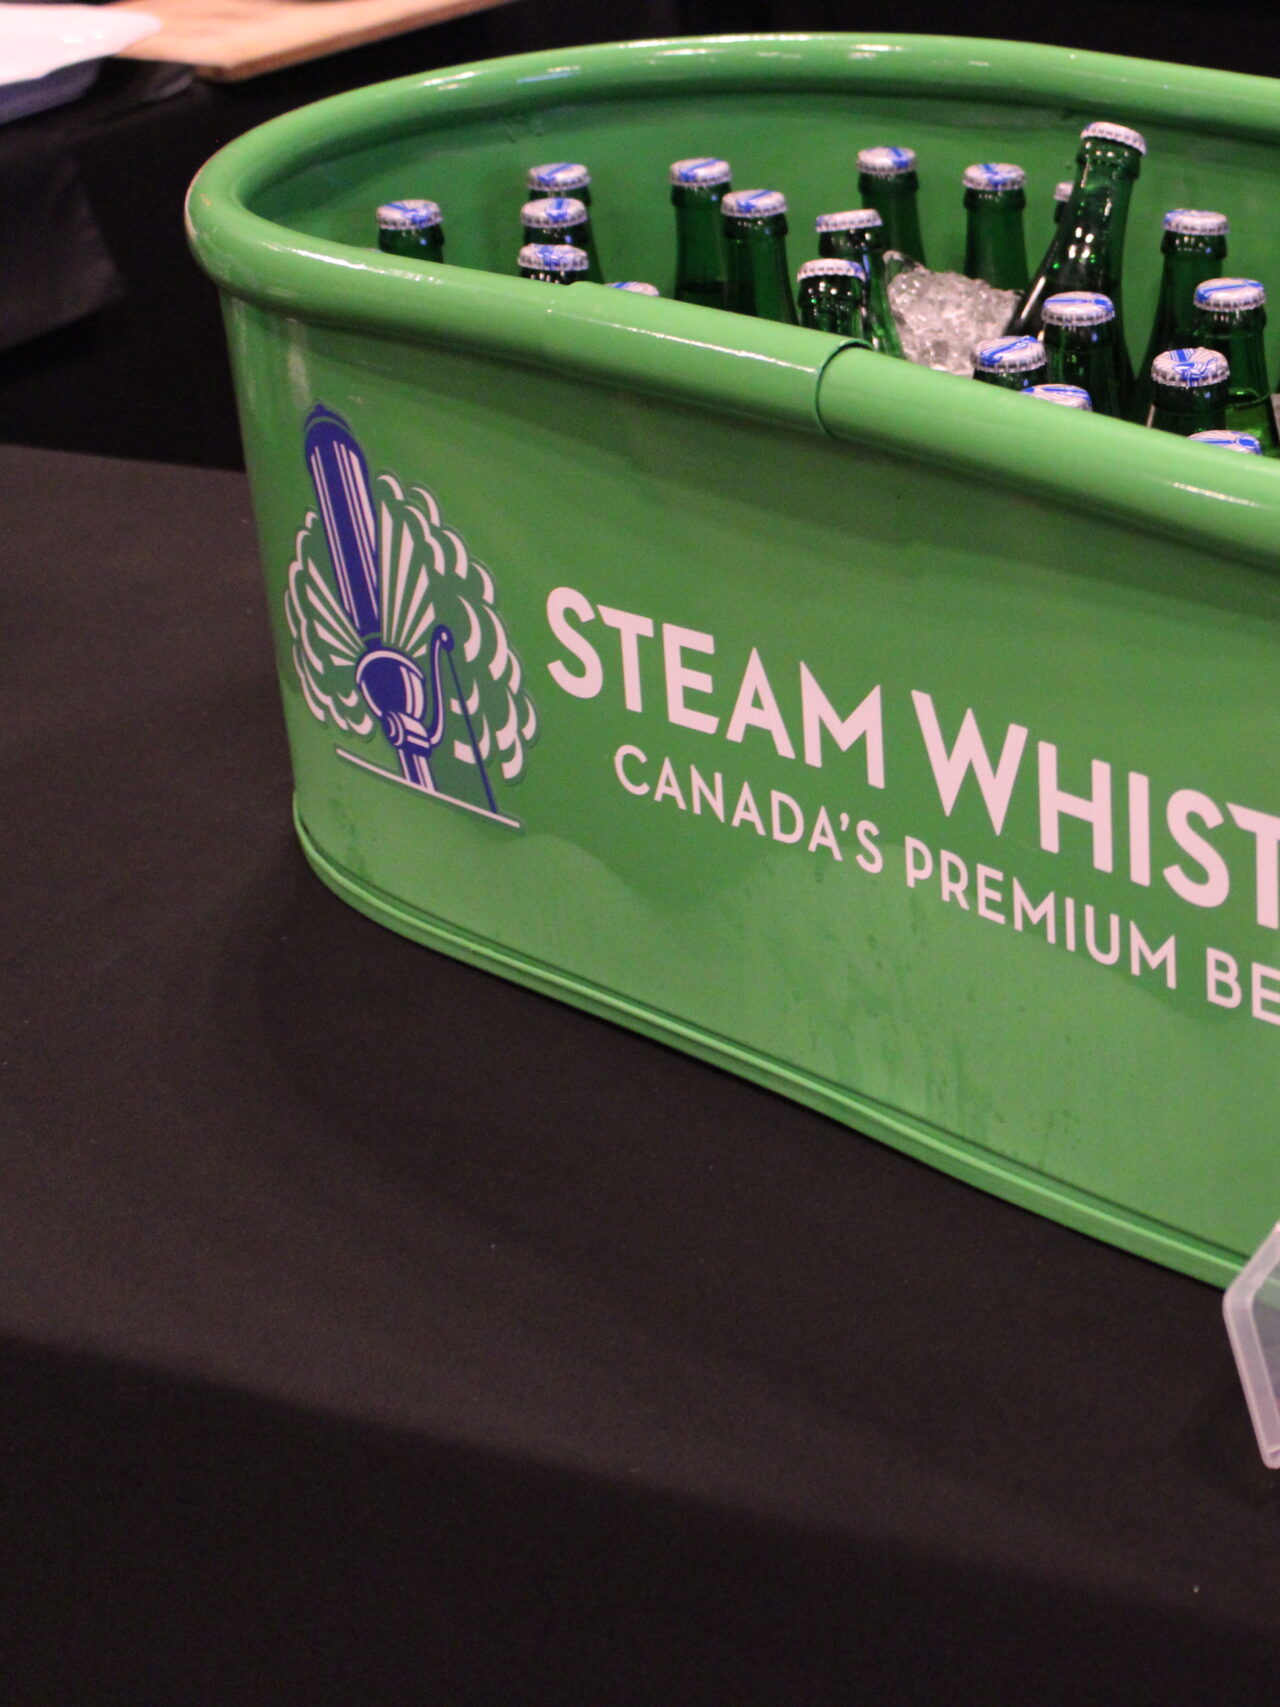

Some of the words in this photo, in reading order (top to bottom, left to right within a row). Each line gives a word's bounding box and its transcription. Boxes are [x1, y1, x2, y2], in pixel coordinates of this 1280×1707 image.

[546, 586, 886, 790] STEAM
[614, 744, 884, 874] CANADA'S
[904, 835, 1177, 989] PREMIUM
